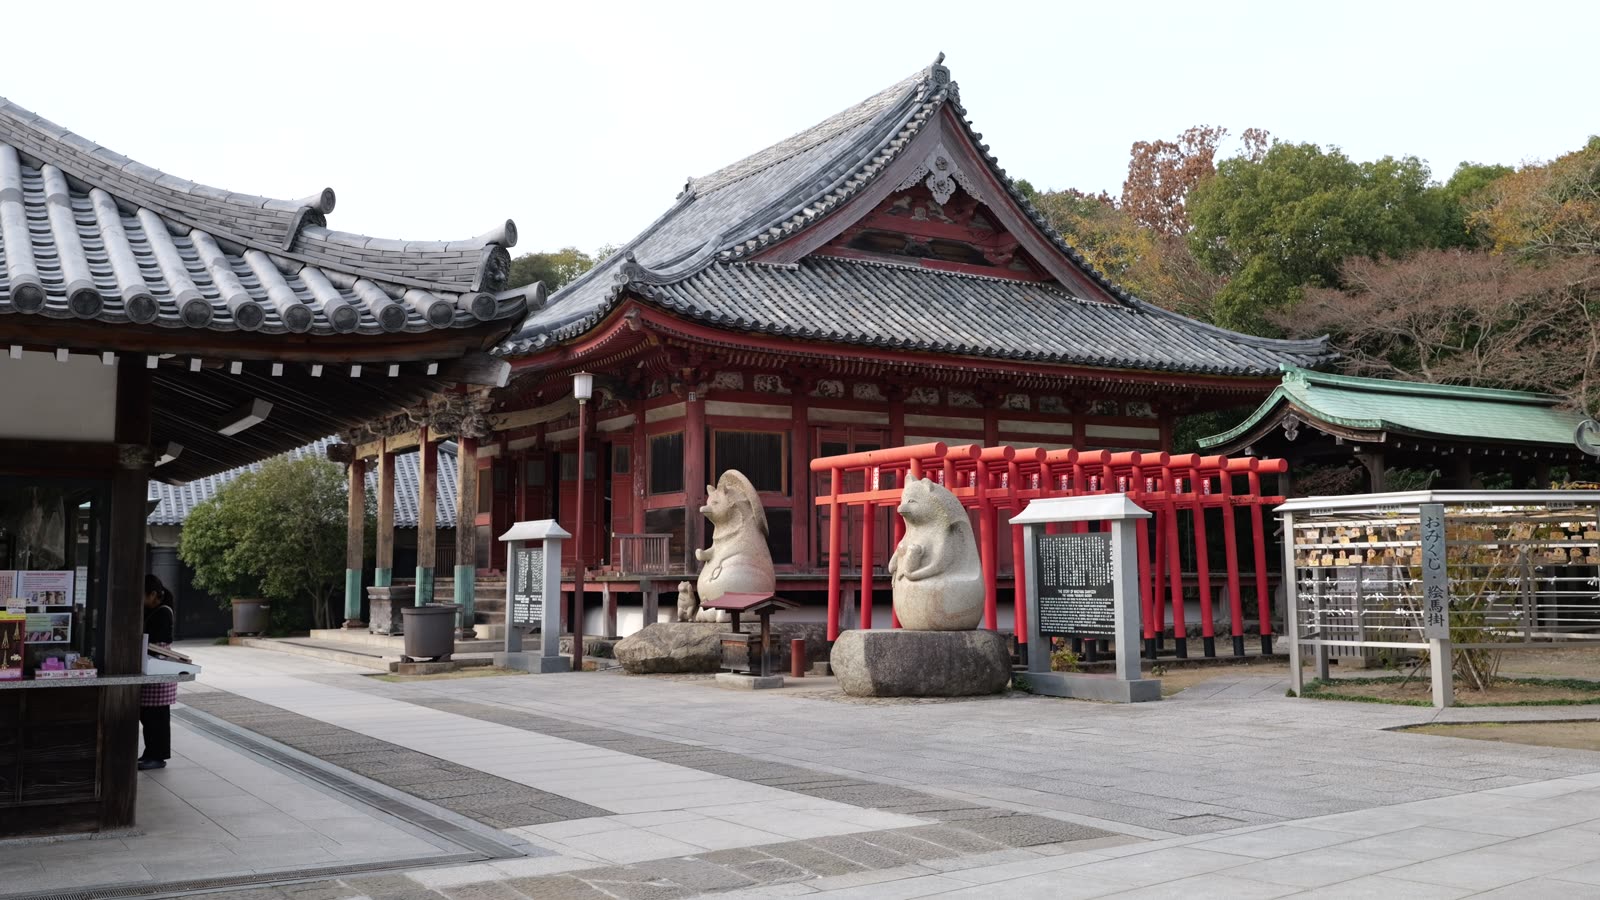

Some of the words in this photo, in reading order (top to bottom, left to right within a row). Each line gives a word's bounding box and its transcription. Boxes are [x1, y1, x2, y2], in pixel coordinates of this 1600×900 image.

[1425, 516, 1445, 627] おみくじ・絵馬掛
